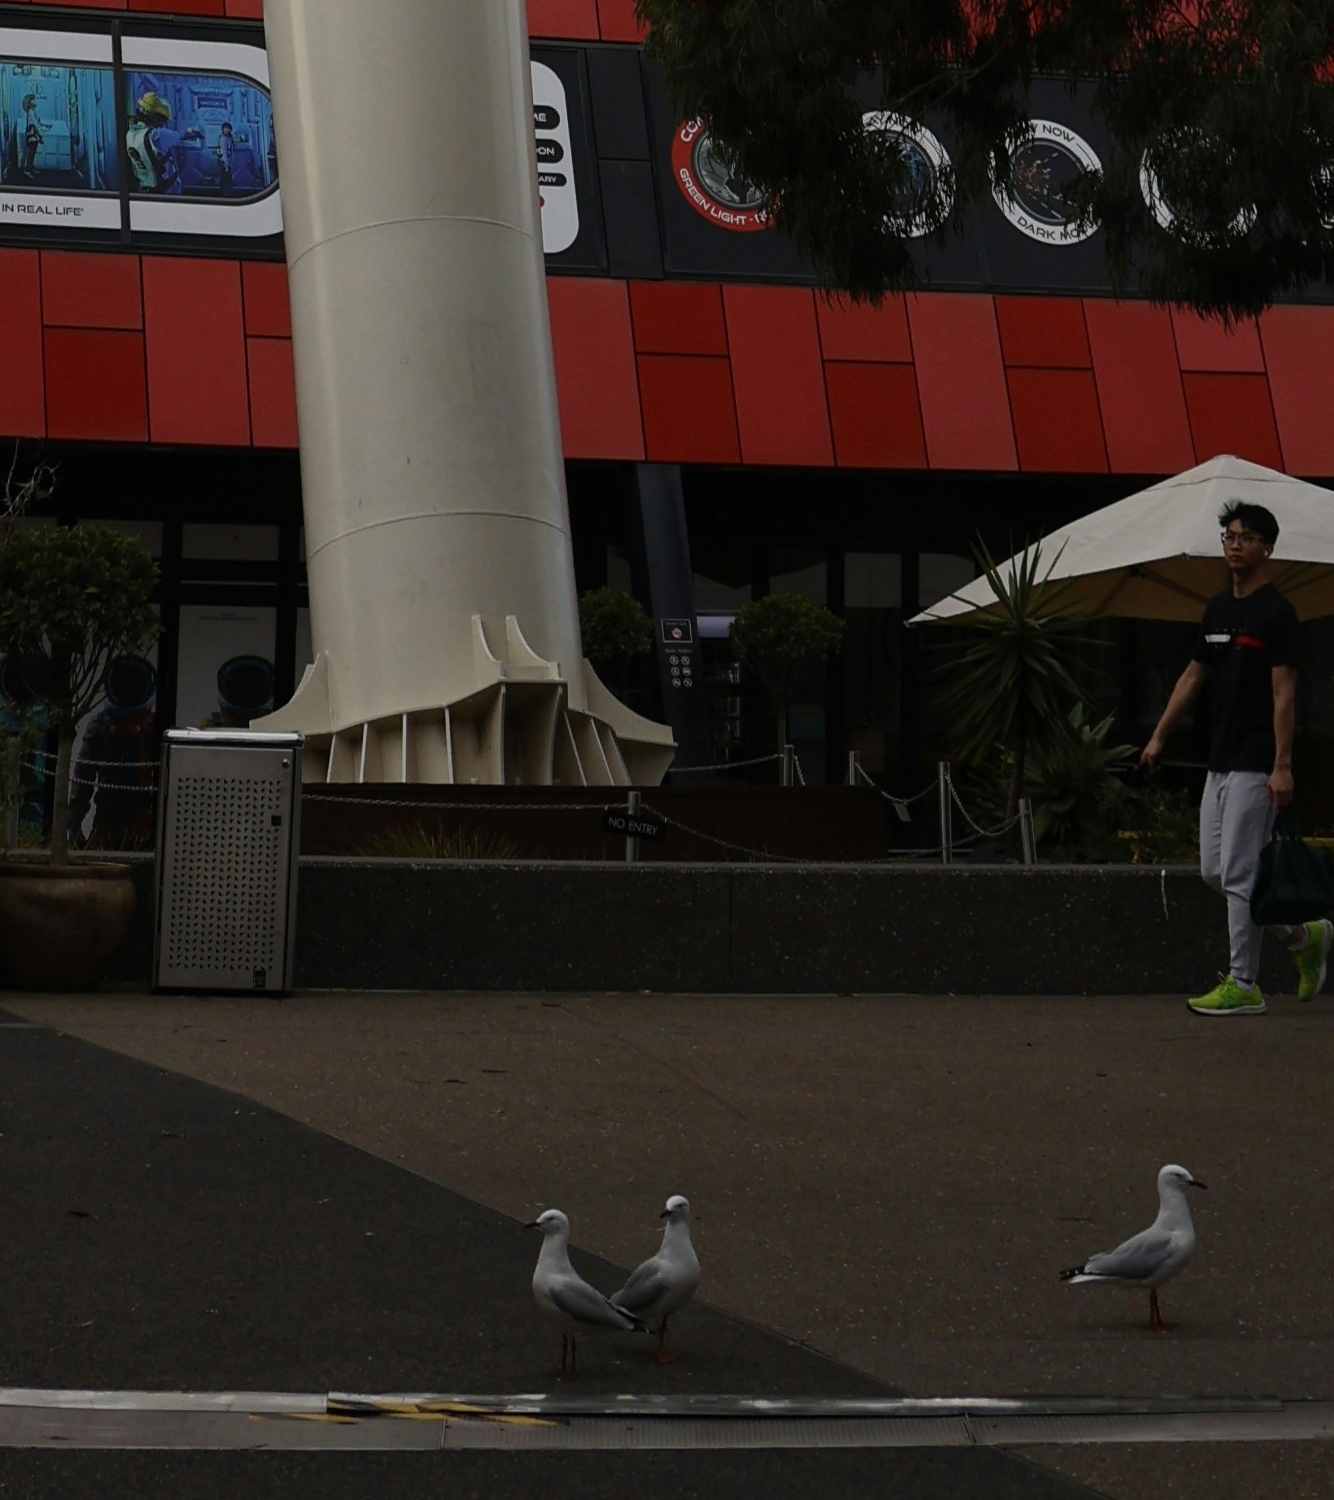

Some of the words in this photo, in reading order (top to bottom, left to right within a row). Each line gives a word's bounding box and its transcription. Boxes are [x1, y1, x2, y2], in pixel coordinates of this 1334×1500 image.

[1042, 123, 1075, 142] NOW
[679, 167, 712, 211] GREEN
[710, 206, 747, 225] LIGHT
[1, 203, 15, 214] IN
[17, 204, 53, 216] REAL
[55, 206, 84, 217] LIFE'
[1017, 216, 1056, 241] DARK
[608, 816, 626, 829] NO
[628, 820, 660, 836] ENTRY
